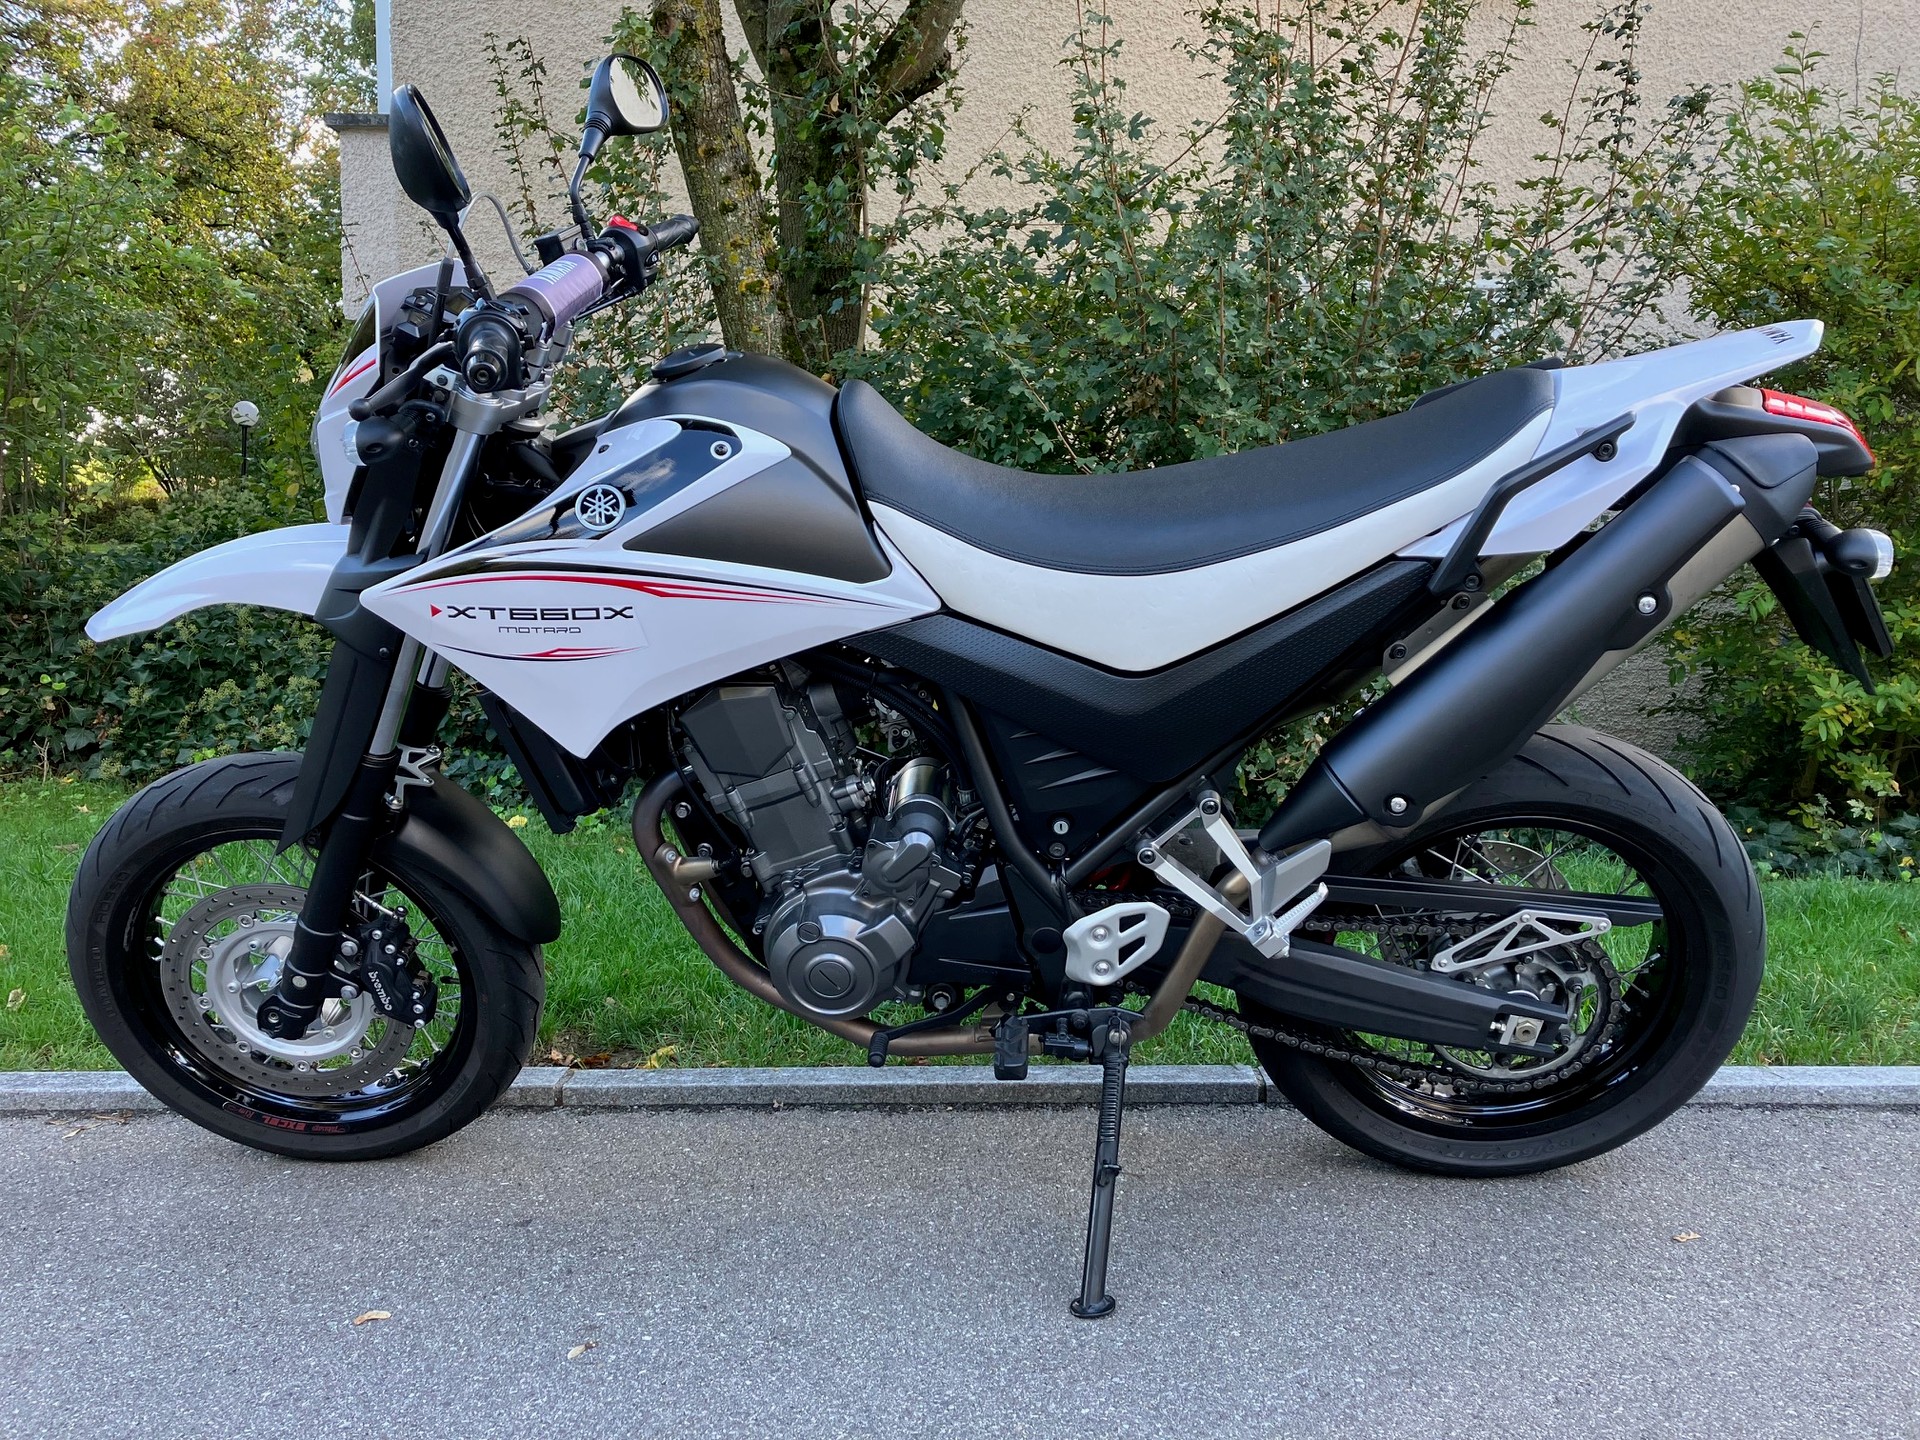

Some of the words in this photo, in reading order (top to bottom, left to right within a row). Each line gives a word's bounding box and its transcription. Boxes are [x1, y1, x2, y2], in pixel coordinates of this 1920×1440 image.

[447, 606, 634, 621] XT660X
[498, 626, 582, 634] MOTARD
[368, 970, 393, 1011] brembo
[262, 1114, 306, 1131] EXCEL
